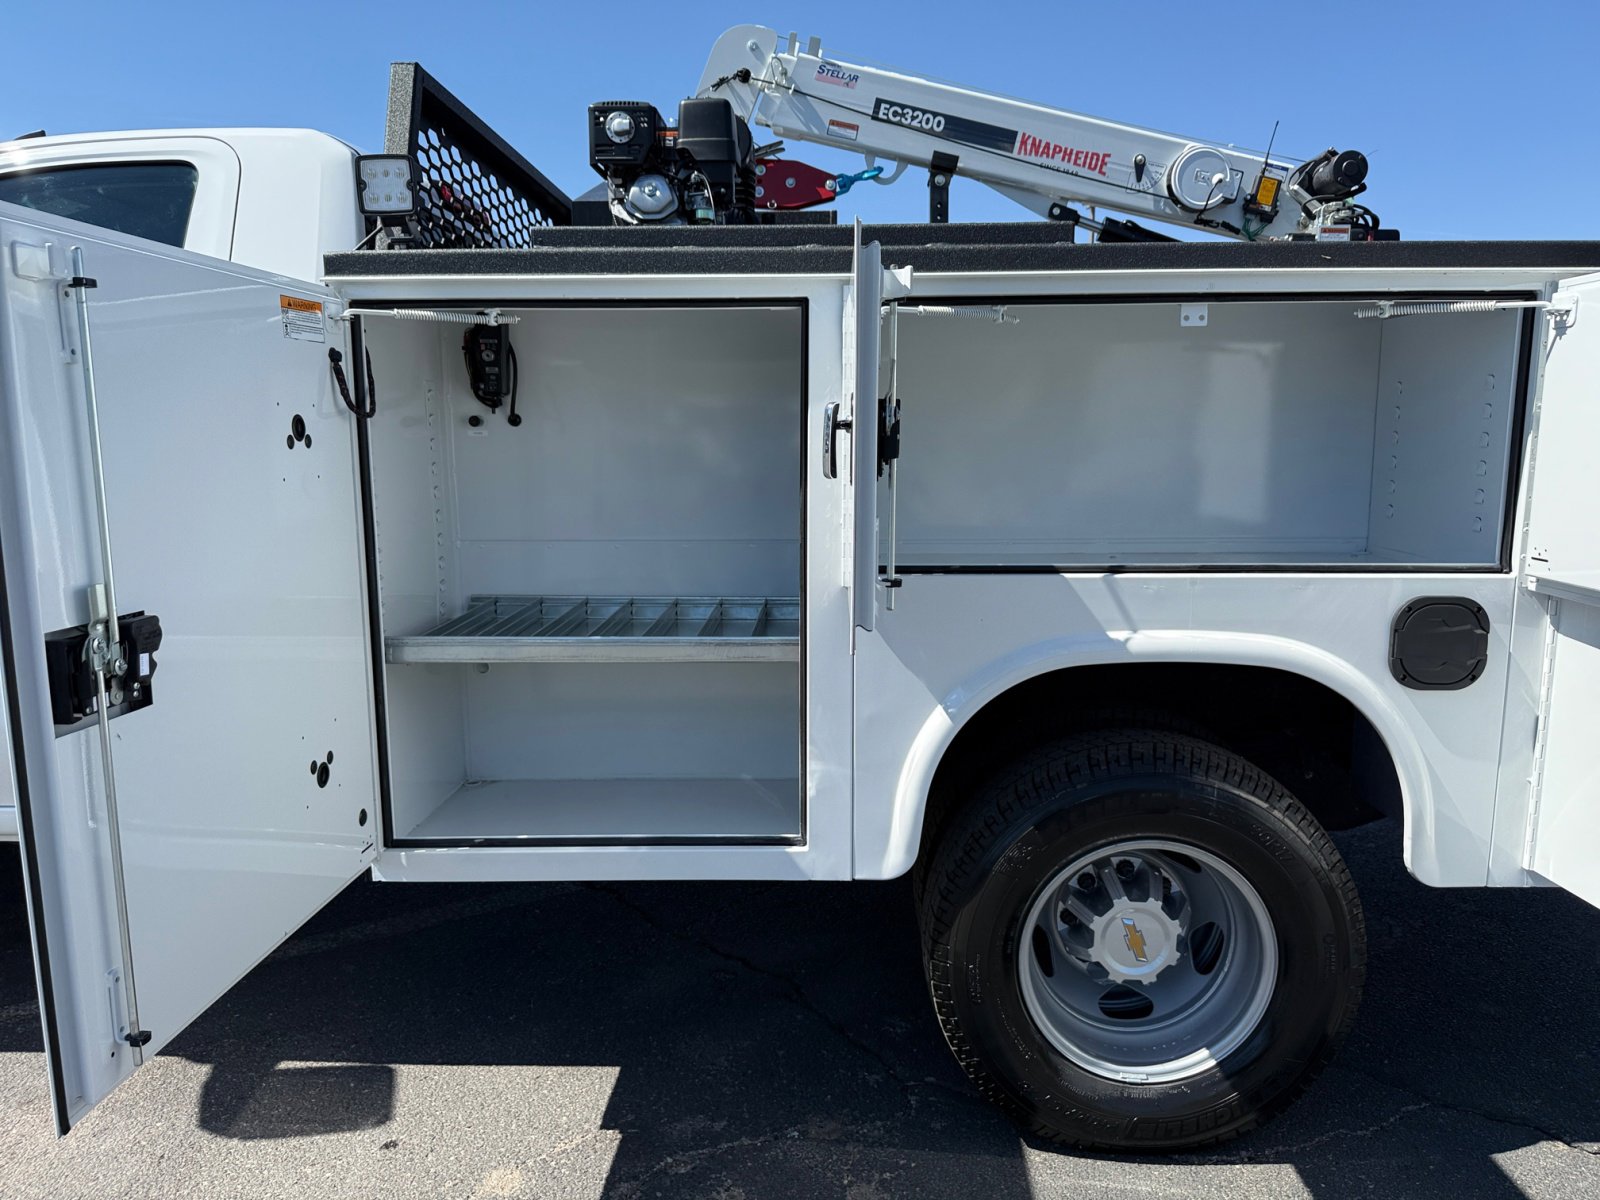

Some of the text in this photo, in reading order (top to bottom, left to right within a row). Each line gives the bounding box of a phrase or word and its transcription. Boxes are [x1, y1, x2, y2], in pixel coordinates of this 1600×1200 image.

[817, 64, 859, 83] STELLAR
[878, 102, 946, 133] EC3200
[1017, 131, 1112, 177] KNAPHEIDE
